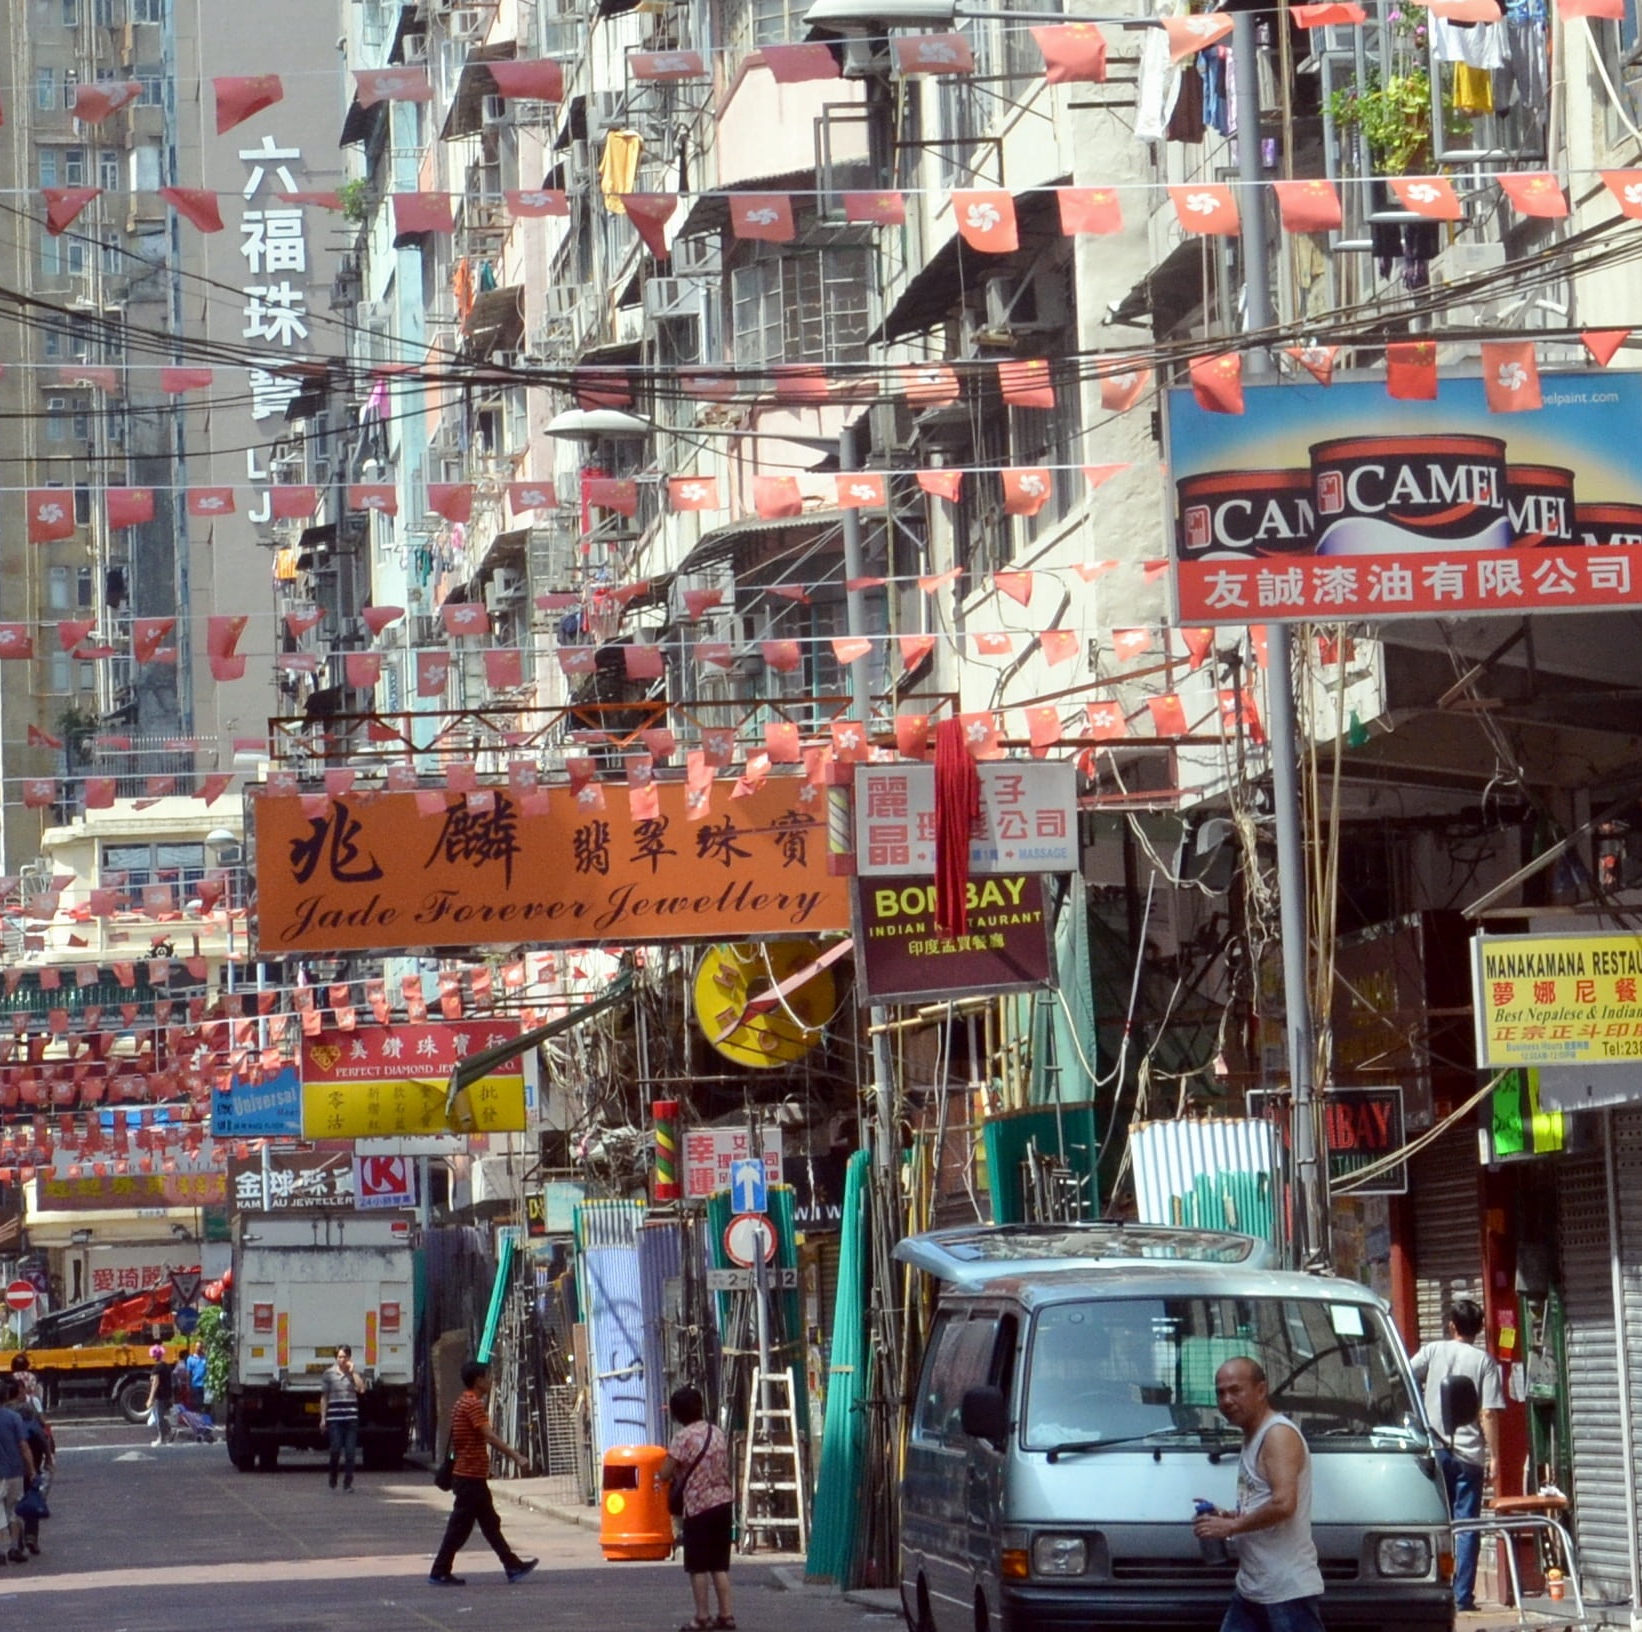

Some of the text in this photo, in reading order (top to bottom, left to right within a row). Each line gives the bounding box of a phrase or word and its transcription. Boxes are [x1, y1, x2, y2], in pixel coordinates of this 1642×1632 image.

[1347, 461, 1505, 514] CAMEL
[1204, 555, 1631, 609] 友誠漆油有限公司
[1018, 847, 1069, 860] MASSAGE
[280, 880, 828, 942] Jade Forever Jewellery
[869, 922, 925, 937] INDIAN
[1486, 952, 1586, 979] MANAKAMANA
[1494, 1008, 1524, 1023] Best
[1526, 1006, 1584, 1025] Nepalese
[1586, 1005, 1598, 1019] &
[335, 1065, 381, 1078] PERFECT
[383, 1063, 434, 1076] DIAMOND
[232, 1087, 297, 1117] Universal
[236, 1198, 261, 1209] KAM
